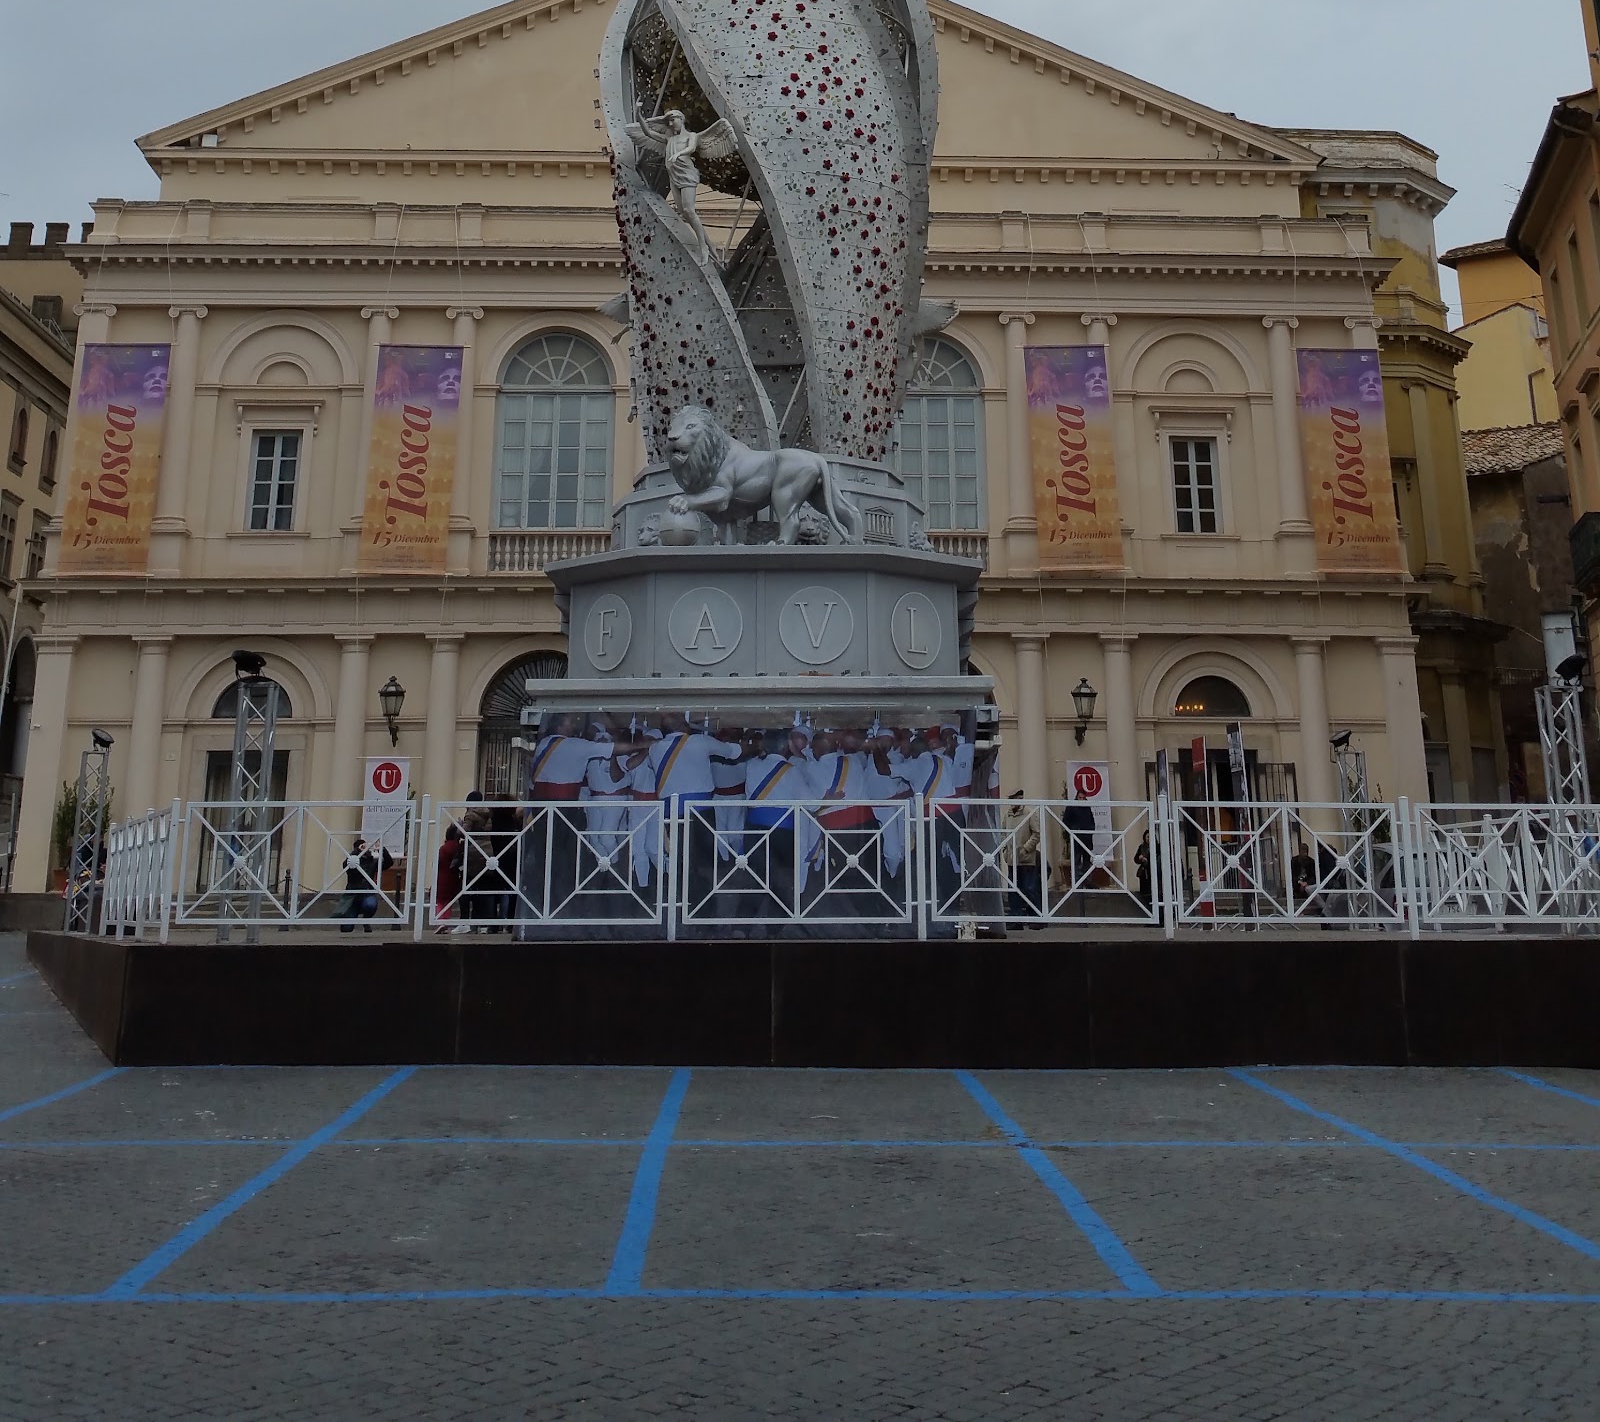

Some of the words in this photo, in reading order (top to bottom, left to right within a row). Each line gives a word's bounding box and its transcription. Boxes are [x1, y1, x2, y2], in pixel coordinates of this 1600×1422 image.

[80, 403, 137, 527] Tosca
[379, 403, 432, 525] Tosca
[1045, 403, 1097, 522] Tosca
[1322, 406, 1374, 525] Tosca
[72, 532, 93, 550] 15
[94, 535, 141, 545] Dicembre
[372, 531, 393, 548] 15
[393, 534, 440, 544] Dicembre
[1048, 528, 1067, 545] 15
[1069, 531, 1113, 540] Dicembre
[1327, 531, 1345, 548] 15
[1346, 533, 1391, 543] Dicembre
[597, 608, 617, 657] F
[685, 603, 726, 650] A
[794, 602, 838, 649] V
[906, 607, 928, 655] L
[376, 770, 398, 789] TU
[1077, 773, 1097, 793] TU
